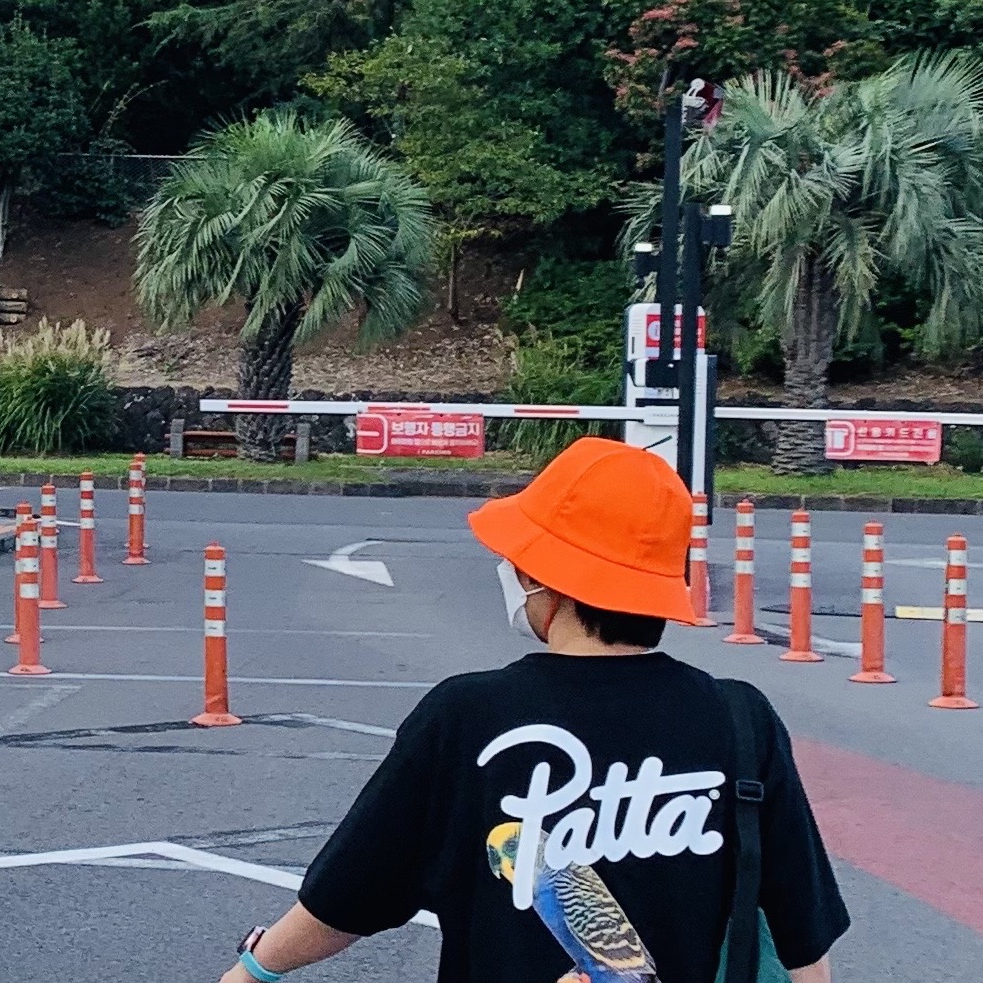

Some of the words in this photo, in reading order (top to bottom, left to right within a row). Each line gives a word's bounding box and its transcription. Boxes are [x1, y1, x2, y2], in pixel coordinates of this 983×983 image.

[391, 421, 428, 435] 보행자
[431, 421, 480, 437] 통행금지
[477, 724, 725, 910] Patta
